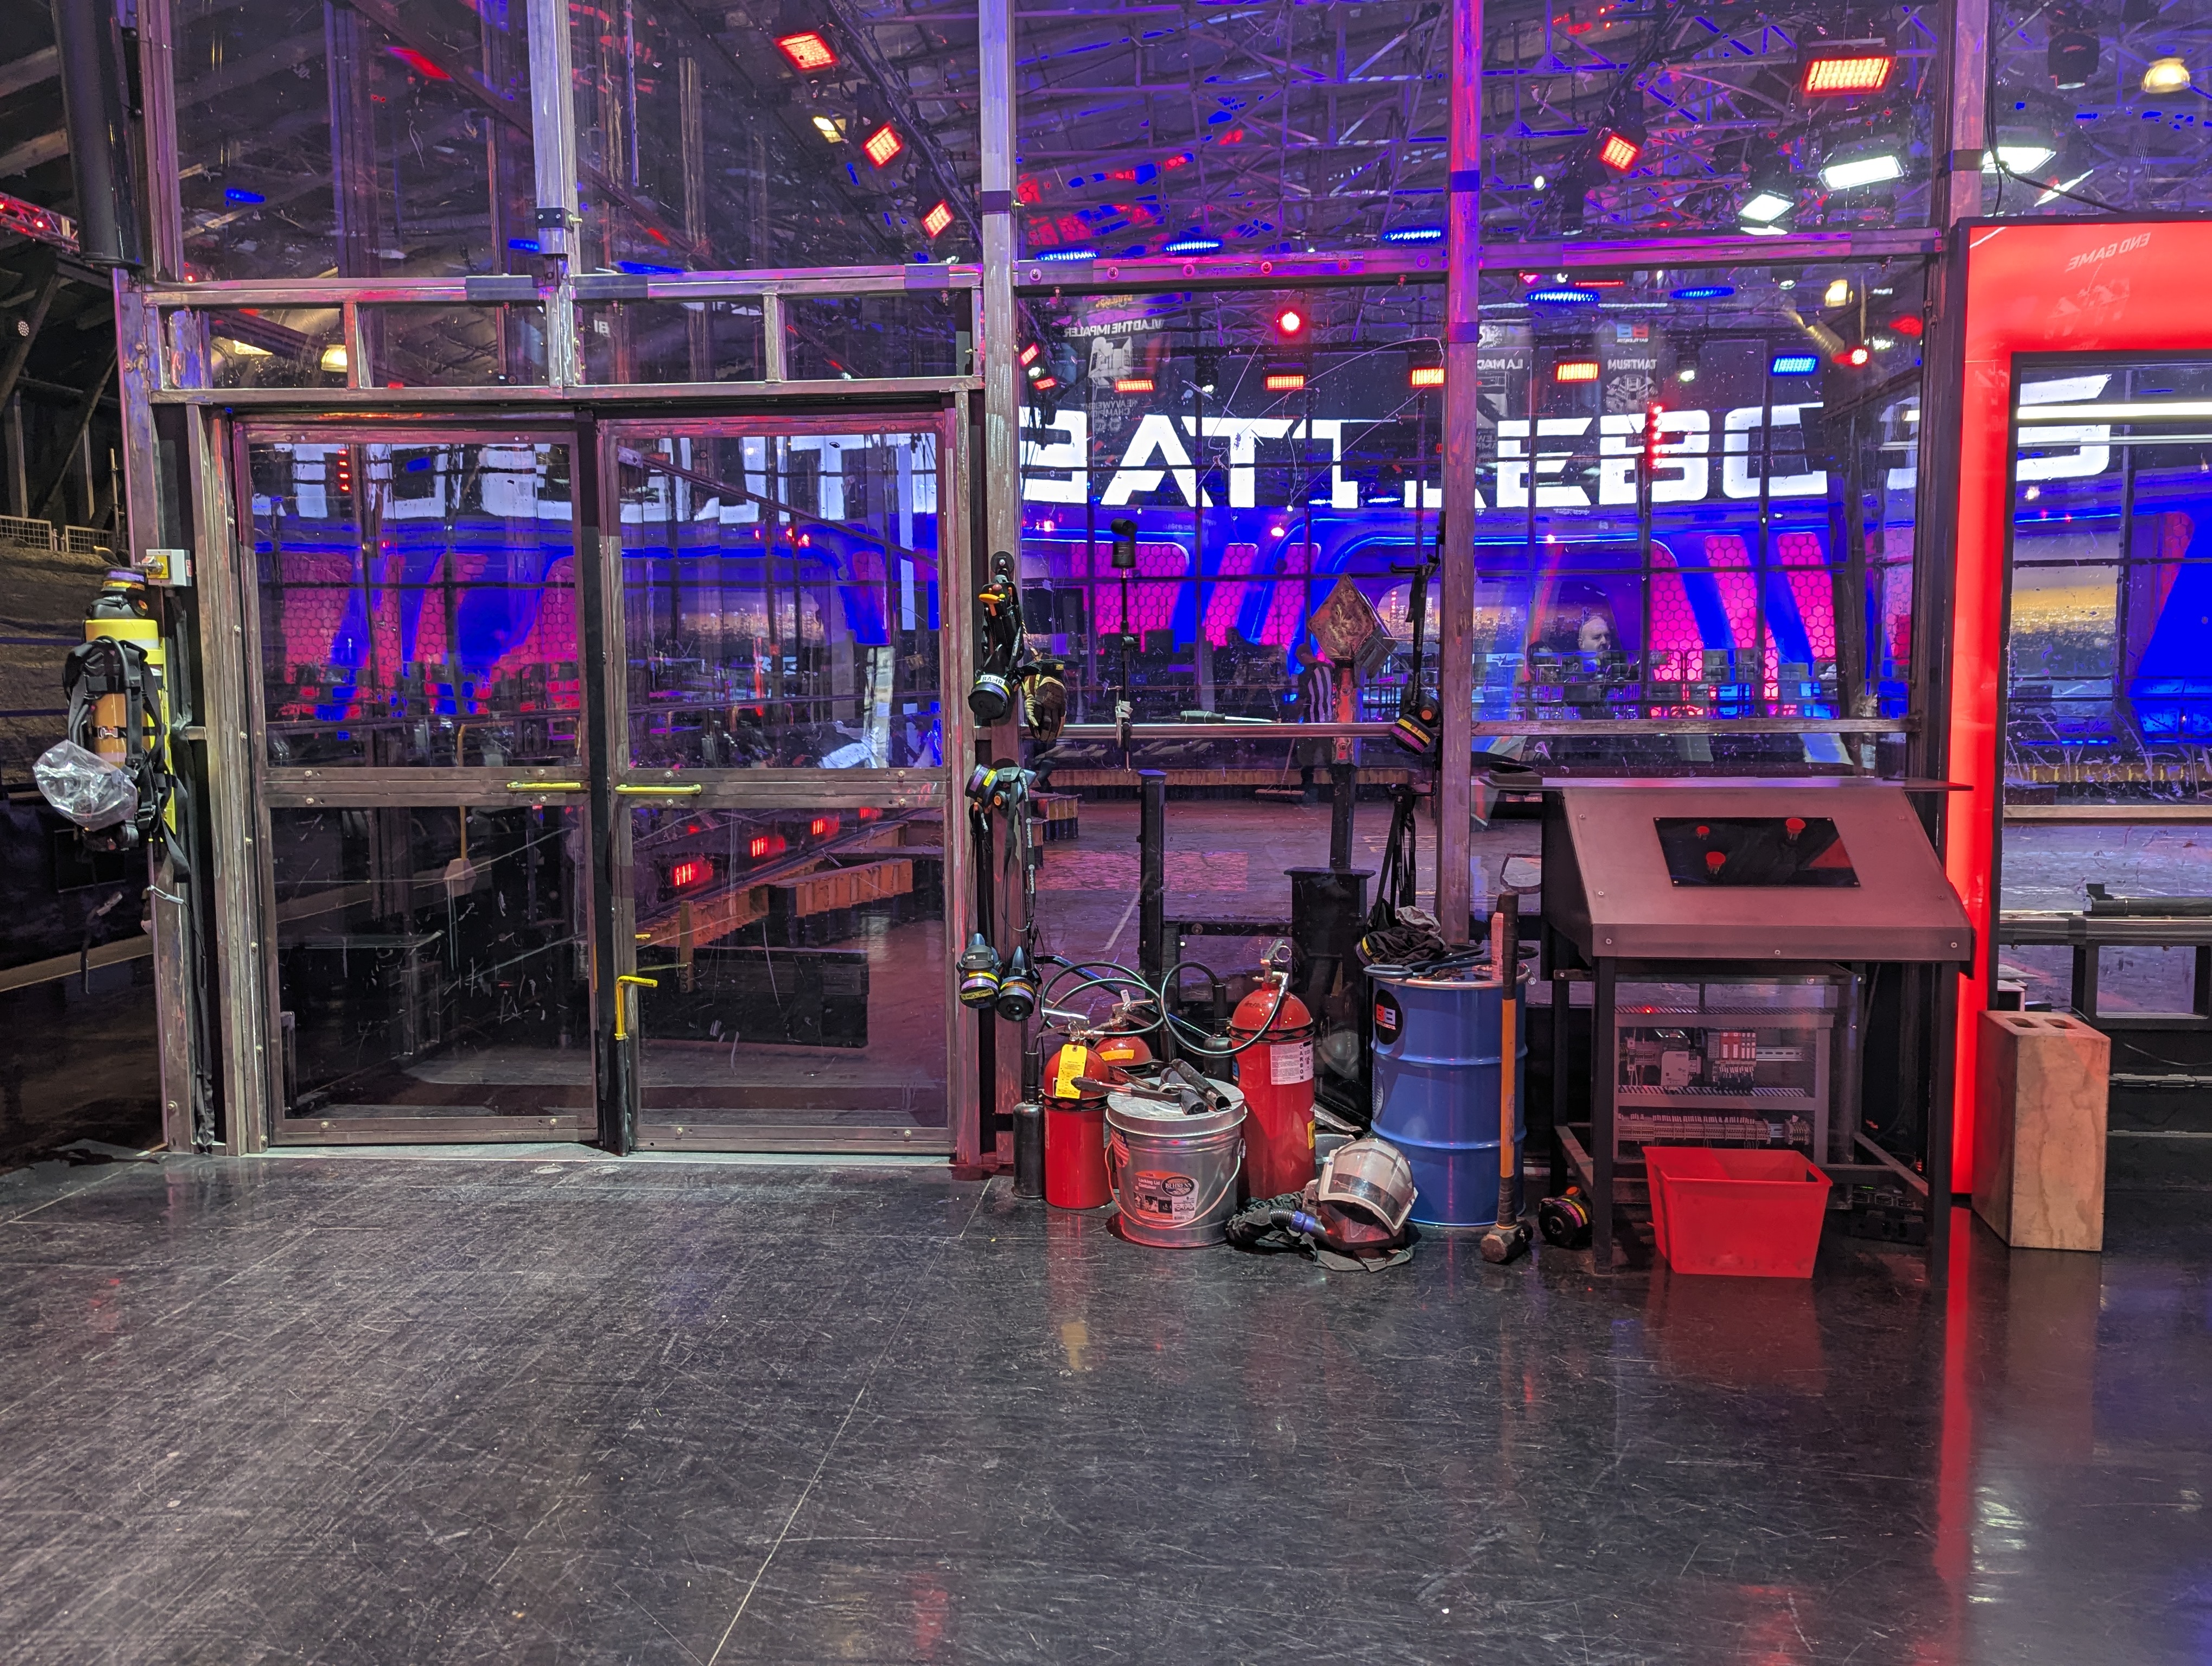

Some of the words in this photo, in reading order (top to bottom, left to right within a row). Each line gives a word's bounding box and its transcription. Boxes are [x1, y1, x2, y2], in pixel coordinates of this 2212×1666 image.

[1019, 373, 2112, 509] BATTLEBOS
[981, 676, 1004, 685] BAHR
[1138, 1182, 1157, 1190] Container
